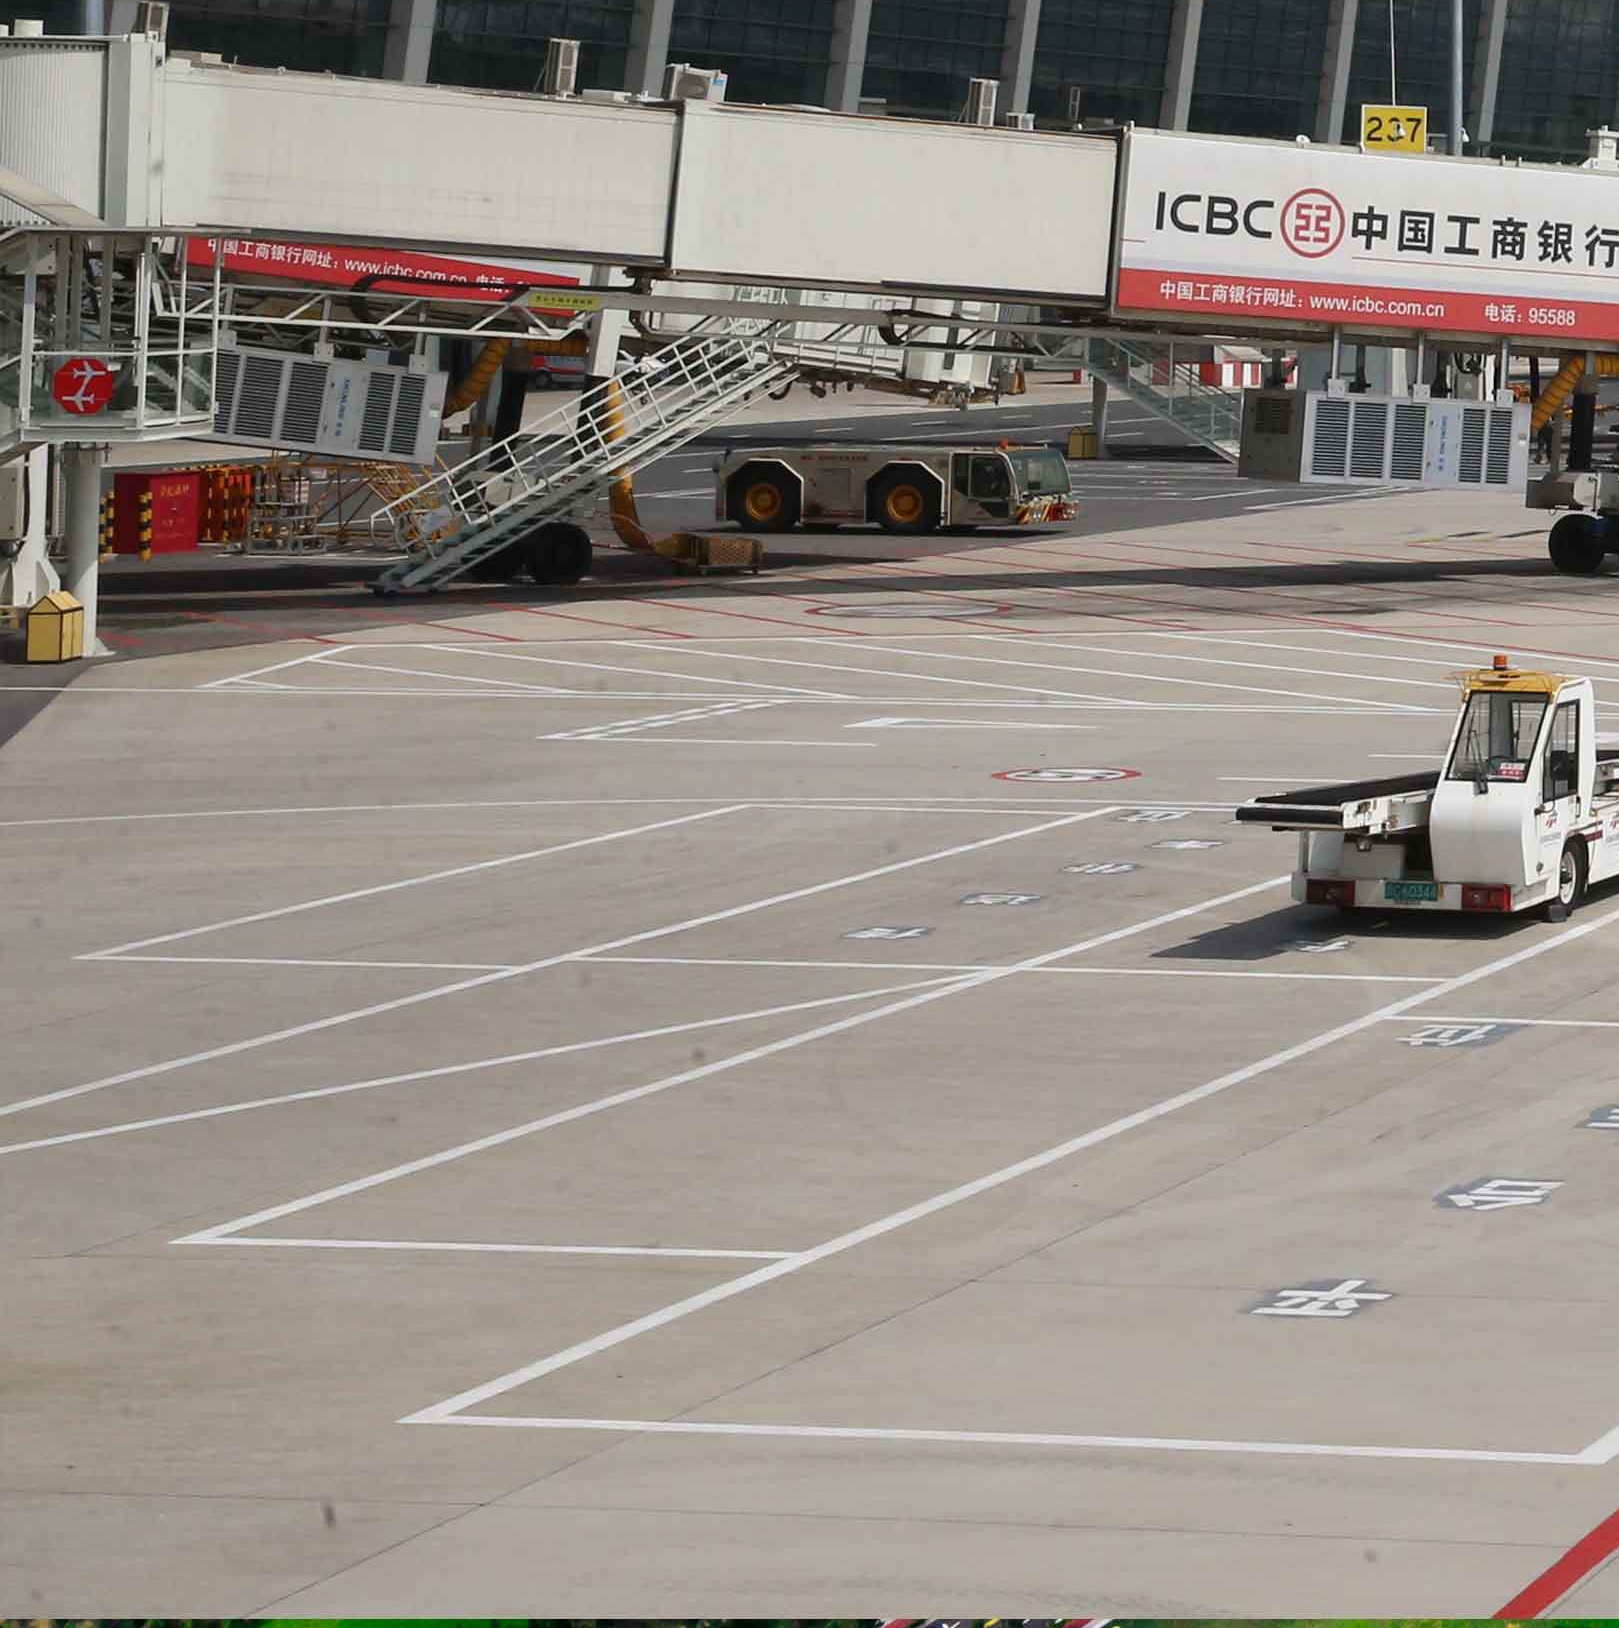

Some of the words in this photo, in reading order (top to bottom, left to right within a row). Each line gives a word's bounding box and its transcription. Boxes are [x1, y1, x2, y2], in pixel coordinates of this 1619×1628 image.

[1155, 191, 1275, 240] ICBC
[1309, 294, 1445, 318] www.icbc.com.cn
[1528, 306, 1576, 327] 95588
